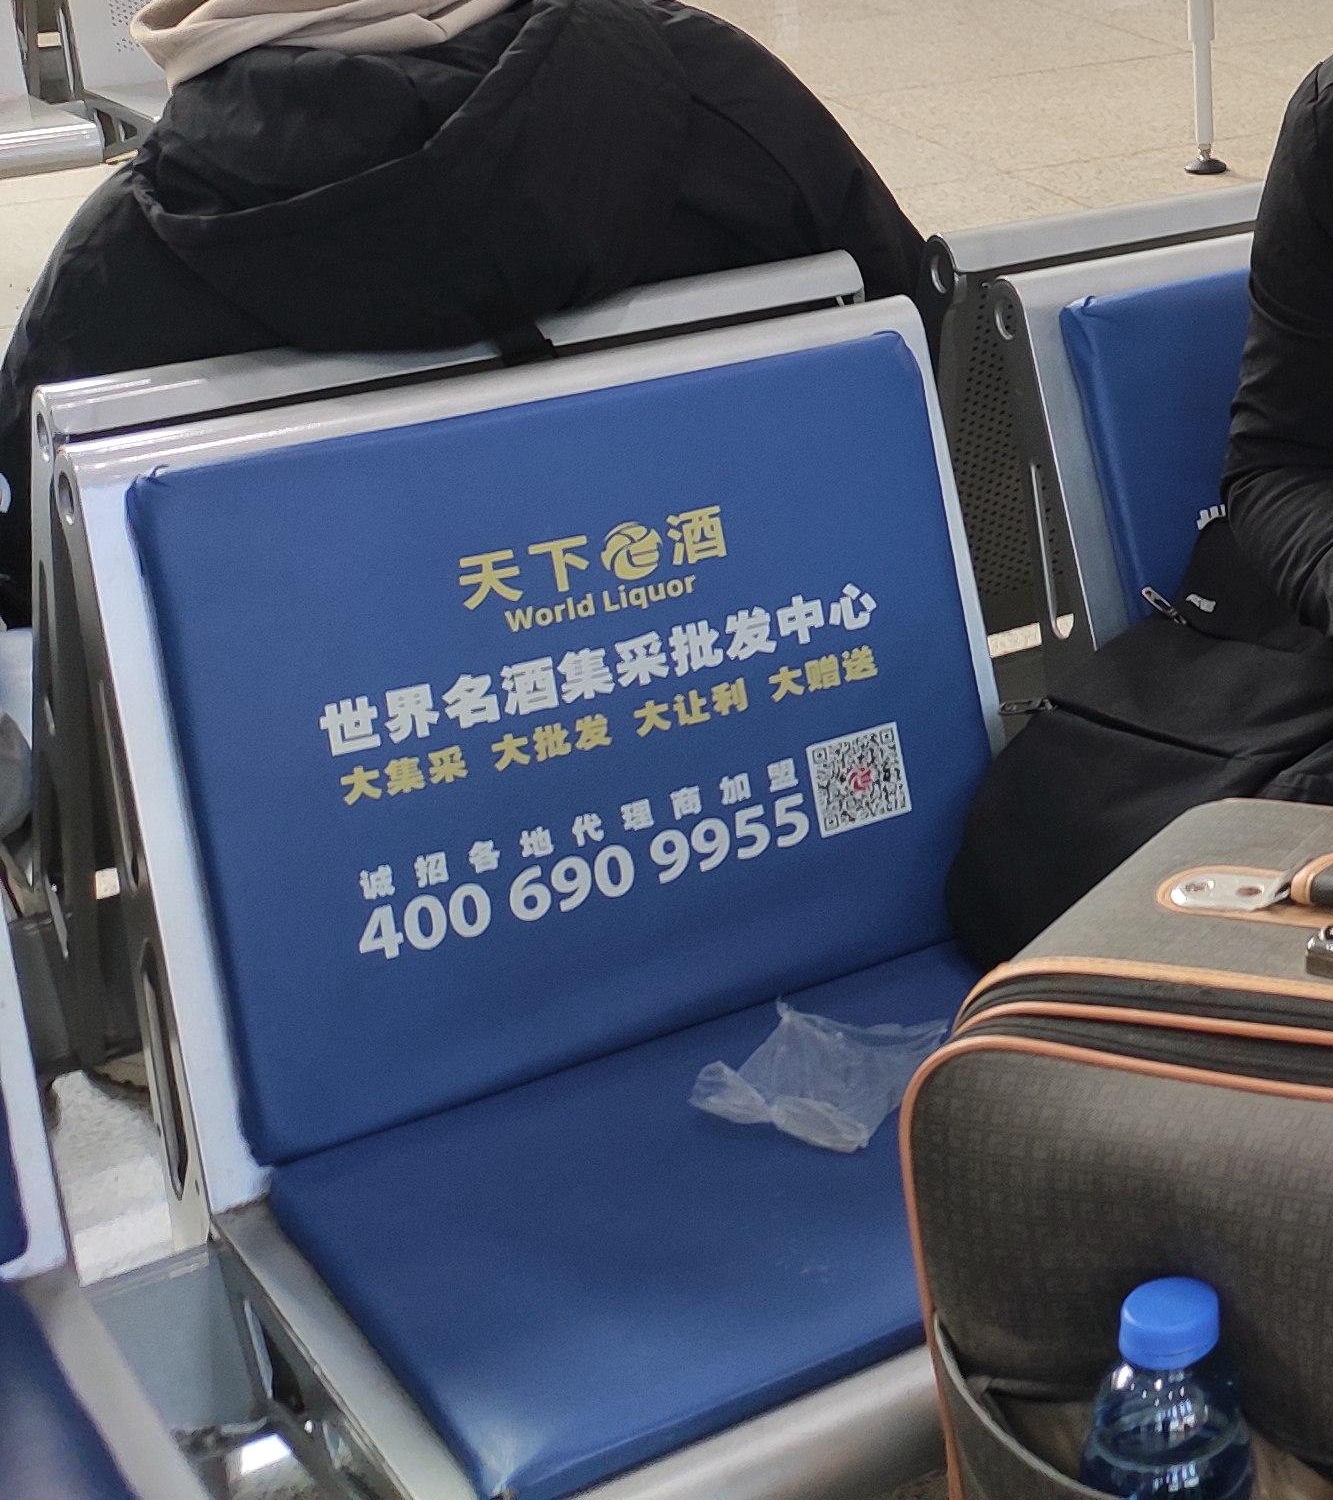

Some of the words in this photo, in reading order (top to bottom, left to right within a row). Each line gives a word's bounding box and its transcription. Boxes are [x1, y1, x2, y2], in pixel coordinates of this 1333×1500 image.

[319, 582, 879, 757] 世界名酒集采批发中心
[505, 593, 596, 633] World
[602, 574, 696, 613] Liquor
[340, 746, 468, 806] 大集采
[492, 714, 613, 773] 大批发
[633, 677, 750, 735] 大让利
[769, 645, 880, 702] 大赠送
[357, 883, 492, 960] 400
[508, 844, 635, 922] 690
[649, 794, 811, 884] 9955
[358, 757, 799, 901] 诚招各地代理商加盟
